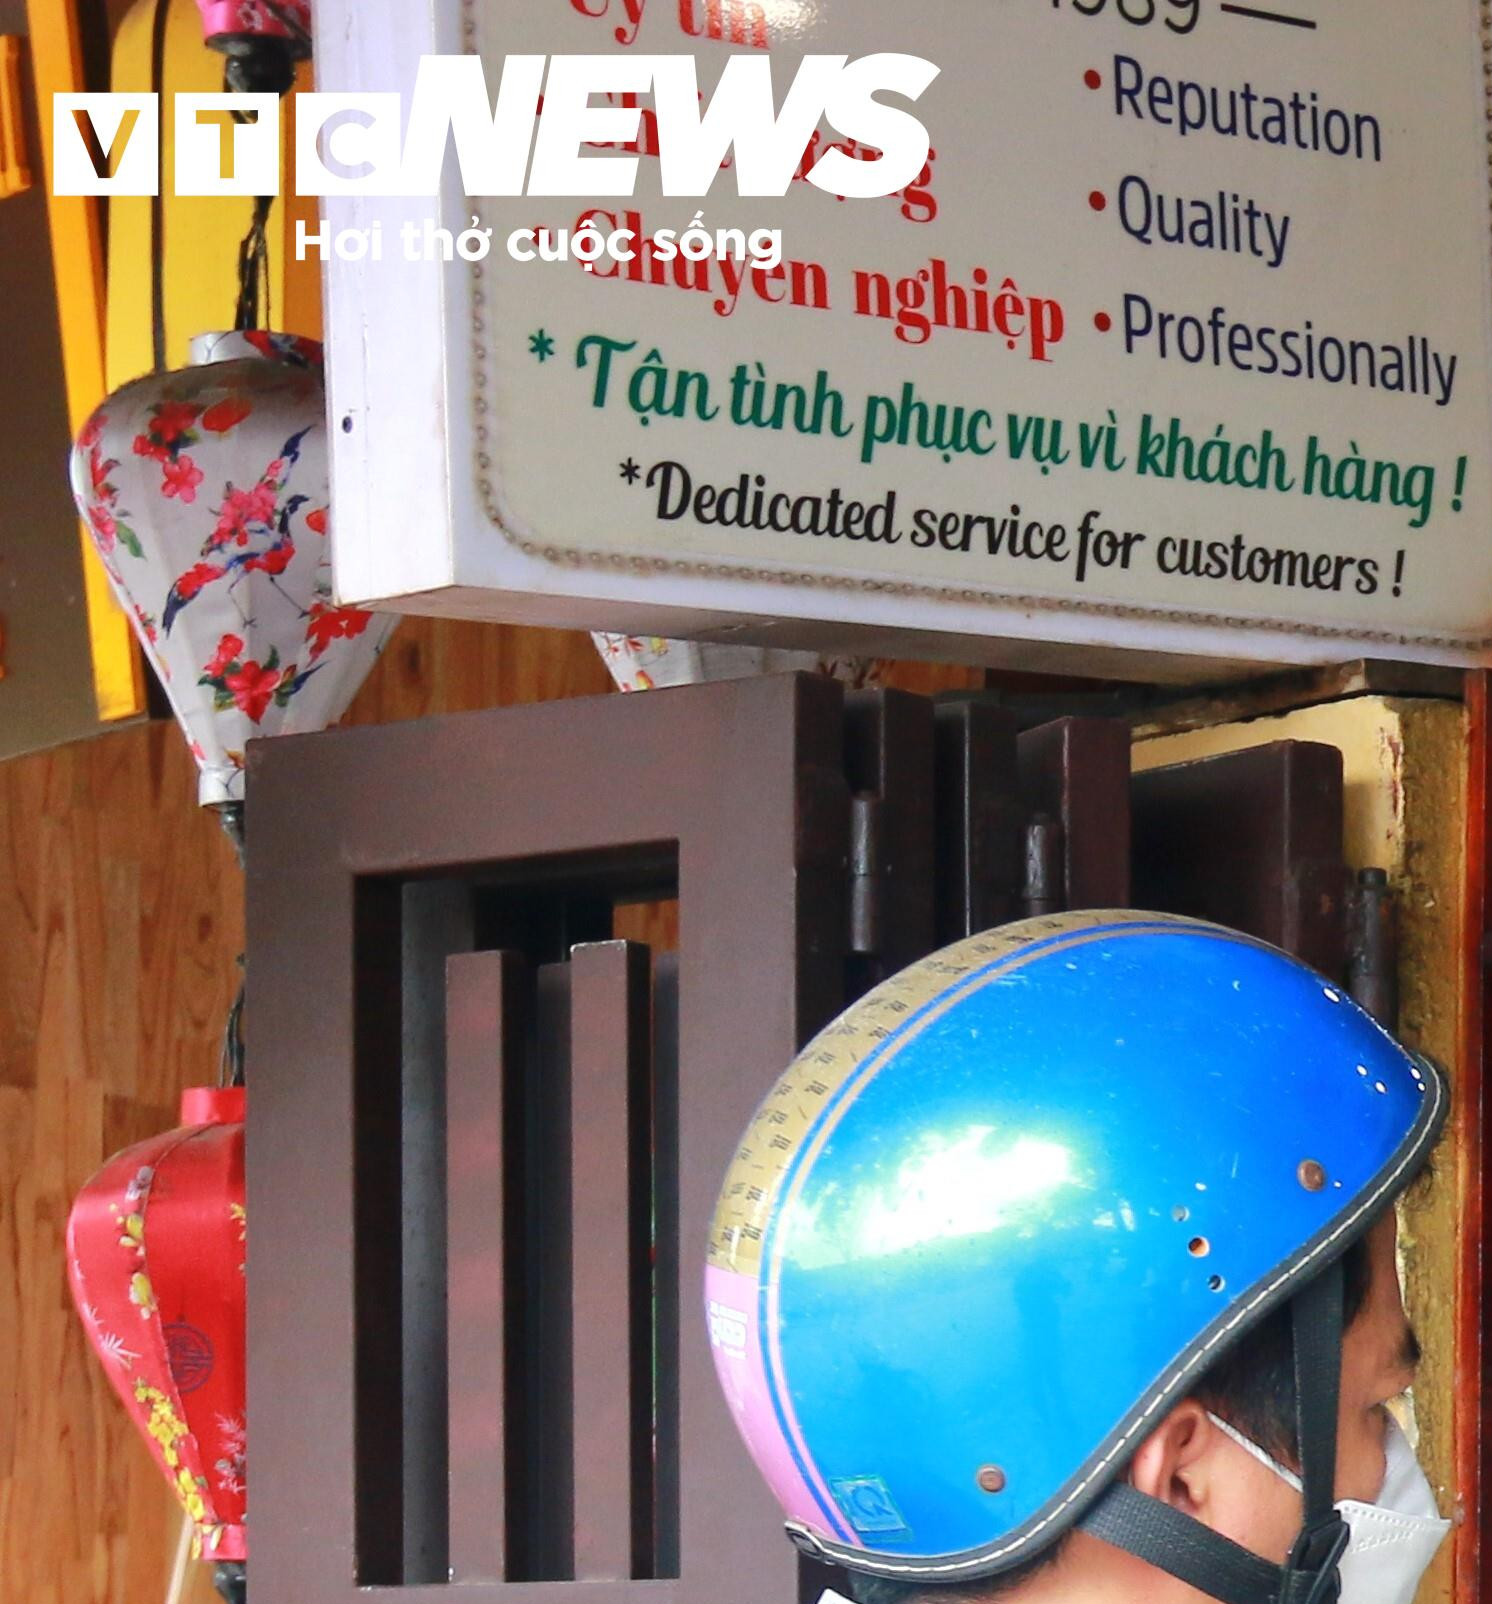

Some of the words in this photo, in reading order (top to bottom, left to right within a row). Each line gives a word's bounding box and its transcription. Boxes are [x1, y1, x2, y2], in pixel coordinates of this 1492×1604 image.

[1114, 54, 1383, 161] Reputation
[1118, 175, 1290, 268] Quality
[852, 258, 1066, 363] nghiệp
[1123, 293, 1458, 406] Professionally
[576, 334, 720, 427] Tận
[729, 361, 854, 438] tình
[861, 381, 996, 464] phục
[1007, 410, 1070, 476] vụ
[1078, 409, 1127, 473] vì
[1137, 415, 1297, 494] khách
[1303, 437, 1437, 528] hàng
[910, 503, 1070, 562] service
[1075, 509, 1145, 581] for
[1156, 534, 1380, 595] customers
